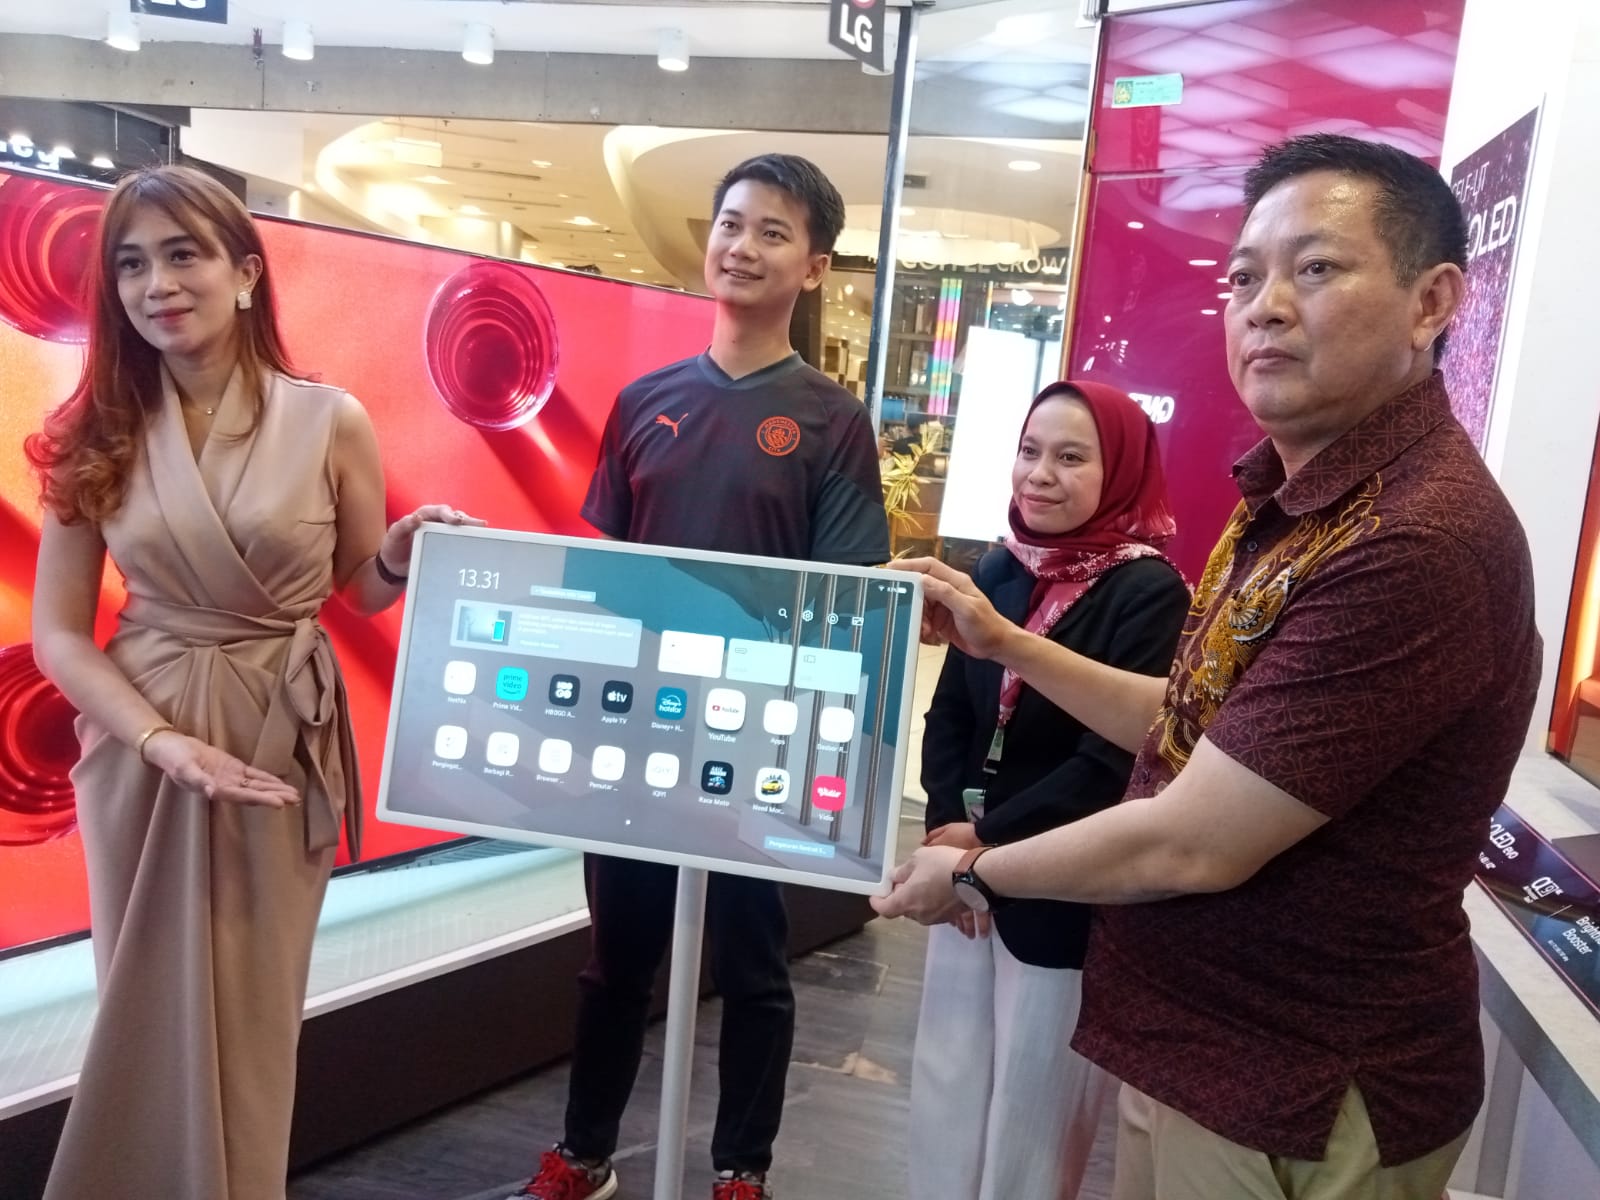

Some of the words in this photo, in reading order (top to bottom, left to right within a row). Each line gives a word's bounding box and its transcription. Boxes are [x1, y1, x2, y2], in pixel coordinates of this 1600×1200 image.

[840, 3, 873, 53] LG
[458, 568, 500, 590] 13.31
[616, 692, 628, 703] tv
[601, 715, 618, 724] Apple
[708, 732, 737, 743] YouTube
[1562, 928, 1593, 955] Booster
